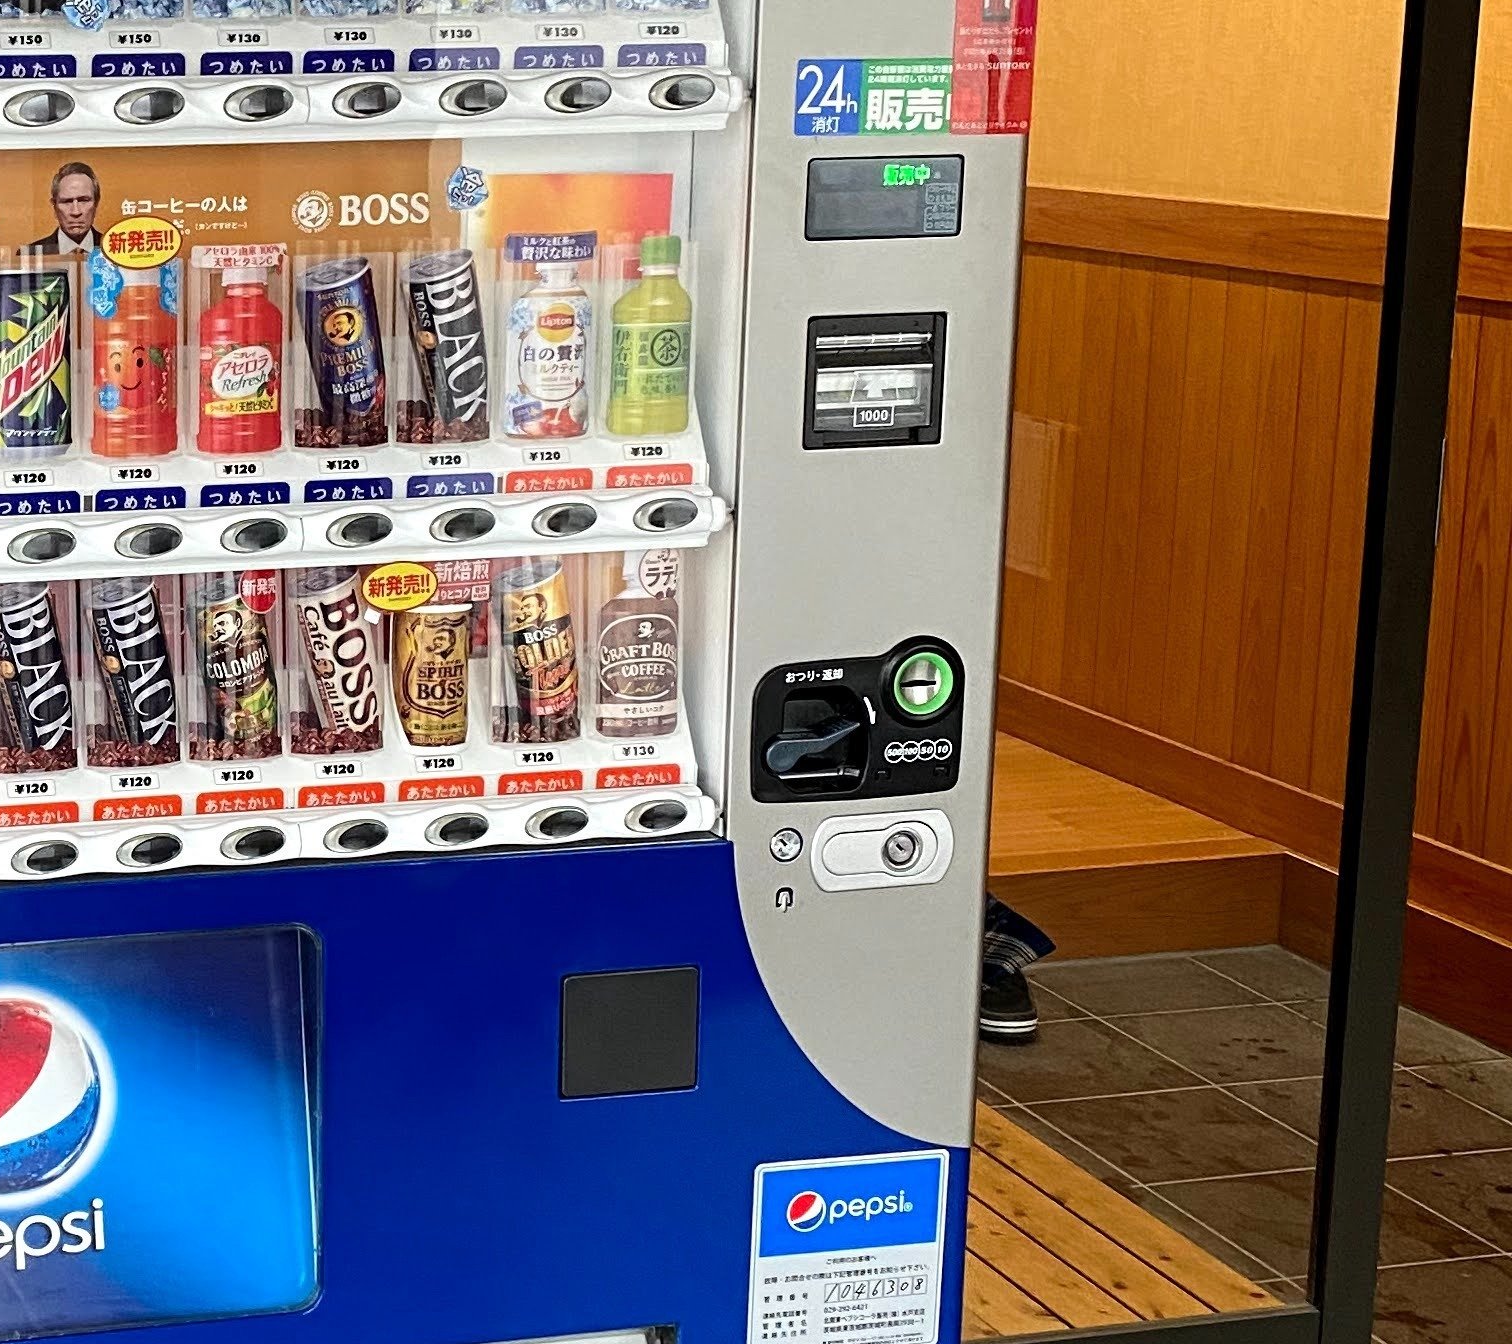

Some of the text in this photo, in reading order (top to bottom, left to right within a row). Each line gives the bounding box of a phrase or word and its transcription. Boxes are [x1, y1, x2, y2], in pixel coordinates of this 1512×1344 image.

[117, 32, 153, 44] ¥150
[226, 33, 261, 44] ¥130
[333, 30, 367, 42] ¥130
[439, 28, 473, 40] ¥130
[543, 26, 578, 38] ¥130
[647, 25, 680, 37] ¥120
[8, 34, 44, 46] ¥150
[208, 58, 284, 74] つめたい
[311, 57, 386, 72] つめたい
[417, 55, 492, 70] つめたい
[521, 54, 595, 68] つめたい
[625, 51, 698, 66] つめたい
[987, 61, 1031, 70] SUNTORY
[100, 60, 176, 78] つめたい
[865, 88, 951, 131] 販売
[812, 116, 841, 132] 消灯
[121, 196, 248, 216] 缶コーヒーの人は
[339, 193, 429, 225] BOSS
[109, 230, 174, 254] 新発売!!
[521, 246, 591, 260] 贅沢な味わい
[413, 290, 433, 328] BOSS
[540, 315, 574, 326] Lipton
[425, 268, 488, 423] BLACK
[657, 334, 677, 360] 茶
[218, 354, 269, 380] アセロラ
[222, 371, 266, 392] Refresh
[859, 410, 888, 422] 1000
[529, 450, 561, 462] ¥120
[630, 446, 663, 458] ¥120
[326, 459, 360, 471] ¥120
[428, 455, 462, 467] ¥120
[118, 467, 152, 480] ¥120
[223, 463, 257, 475] ¥120
[12, 472, 47, 484] ¥120
[513, 476, 585, 492] あたたかい
[614, 472, 685, 487] あたたかい
[311, 485, 385, 500] つめたい
[414, 480, 487, 495] つめたい
[103, 494, 178, 511] つめたい
[208, 489, 282, 505] つめたい
[434, 561, 489, 582] 新焙煎
[242, 578, 276, 595] 新発売
[368, 573, 430, 598] 新発売!!
[96, 617, 116, 653] BOSS
[304, 606, 330, 651] Café
[523, 624, 558, 644] BOSS
[320, 588, 378, 726] BOSS
[600, 642, 650, 665] CRAFT
[107, 593, 178, 744] BLACK
[206, 644, 269, 679] COLOMBIA
[1, 599, 73, 750] BLACK
[417, 664, 464, 678] SPIRIT
[621, 663, 666, 678] COFFEE
[785, 669, 844, 682] おつり・返却
[417, 681, 464, 700] BOSS
[522, 752, 554, 763] ¥120
[622, 745, 655, 757] ¥130
[921, 745, 949, 755] 50 10
[324, 763, 355, 775] ¥120
[423, 758, 455, 769] ¥120
[118, 776, 151, 787] ¥120
[221, 770, 254, 781] ¥120
[603, 770, 673, 787] あたたかい
[14, 783, 49, 794] ¥120
[406, 783, 477, 799] あたたかい
[505, 777, 576, 793] あたたかい
[204, 796, 276, 813] あたたかい
[306, 789, 377, 805] あたたかい
[101, 804, 174, 820] あたたかい
[829, 1190, 905, 1224] pepsi
